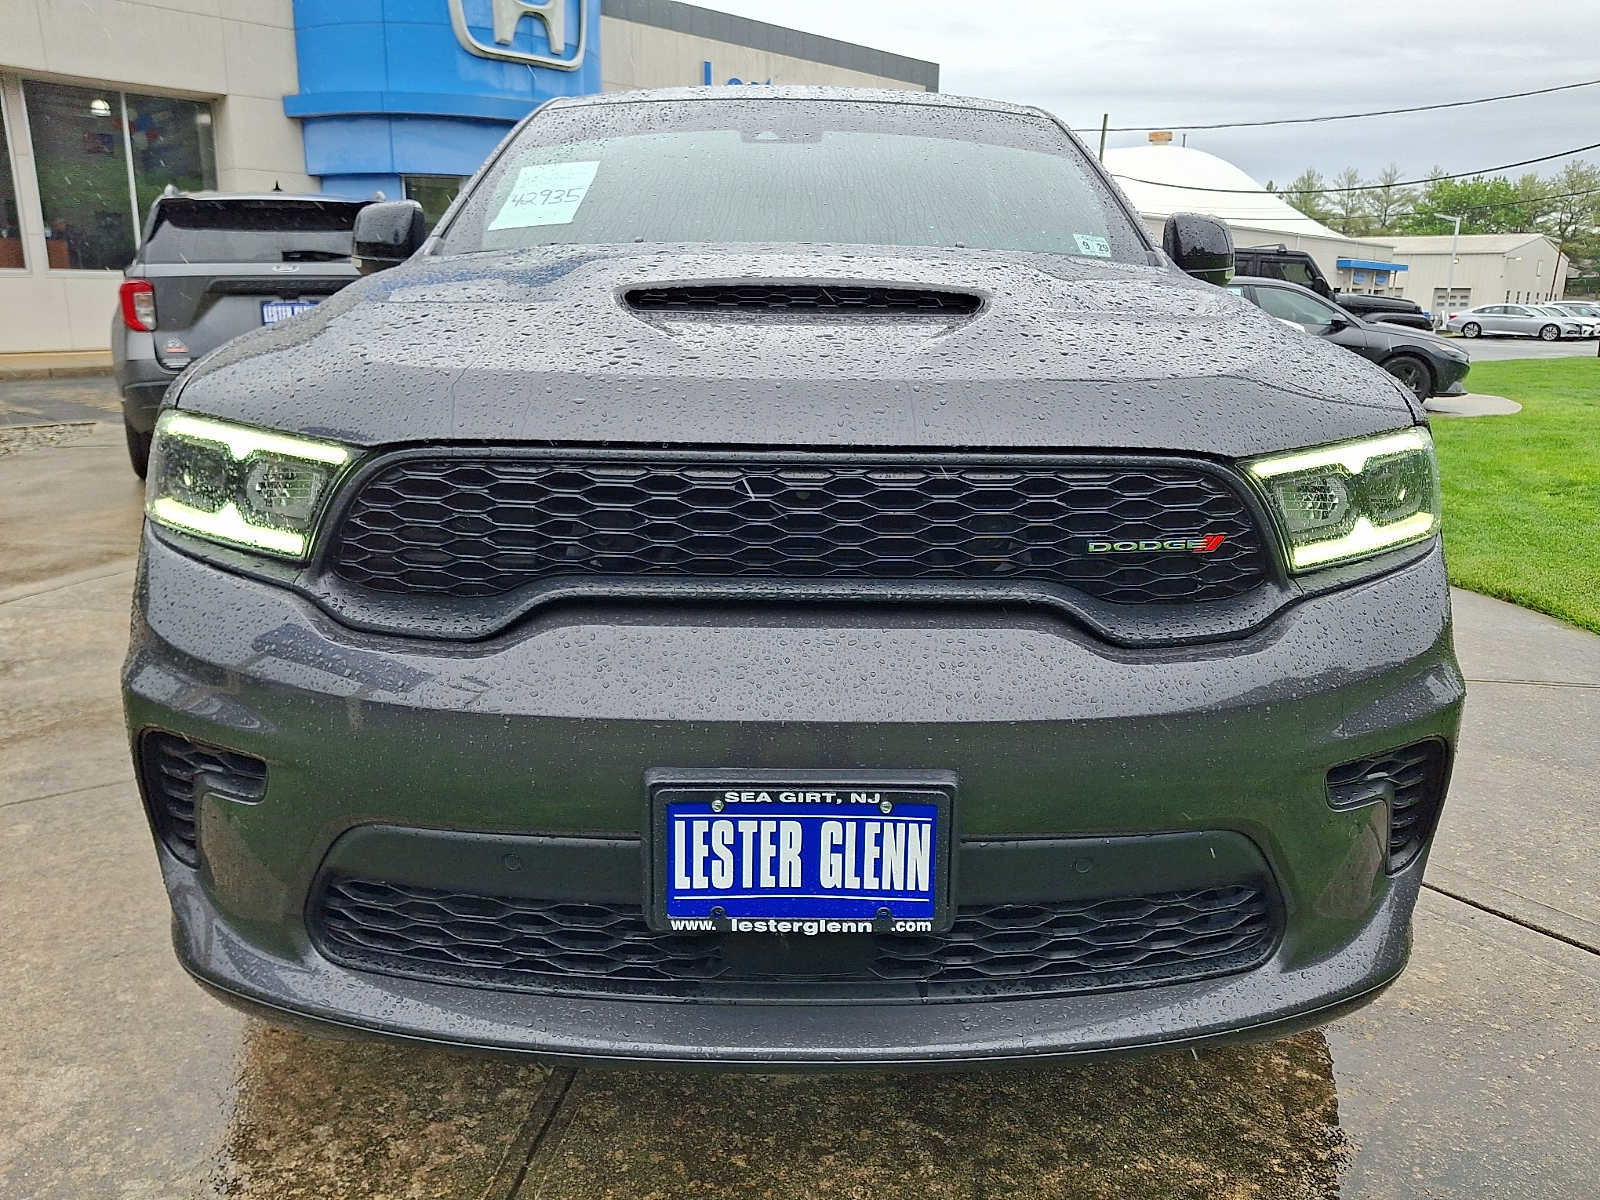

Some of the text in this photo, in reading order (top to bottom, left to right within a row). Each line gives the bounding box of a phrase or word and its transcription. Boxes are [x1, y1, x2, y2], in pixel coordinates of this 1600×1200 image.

[511, 187, 585, 207] 42935
[1088, 539, 1209, 552] DODGE
[724, 791, 881, 804] SEA GIRT, NJ
[673, 819, 932, 892] LESTER GLENN
[670, 918, 932, 936] www. lesterglenn .com
